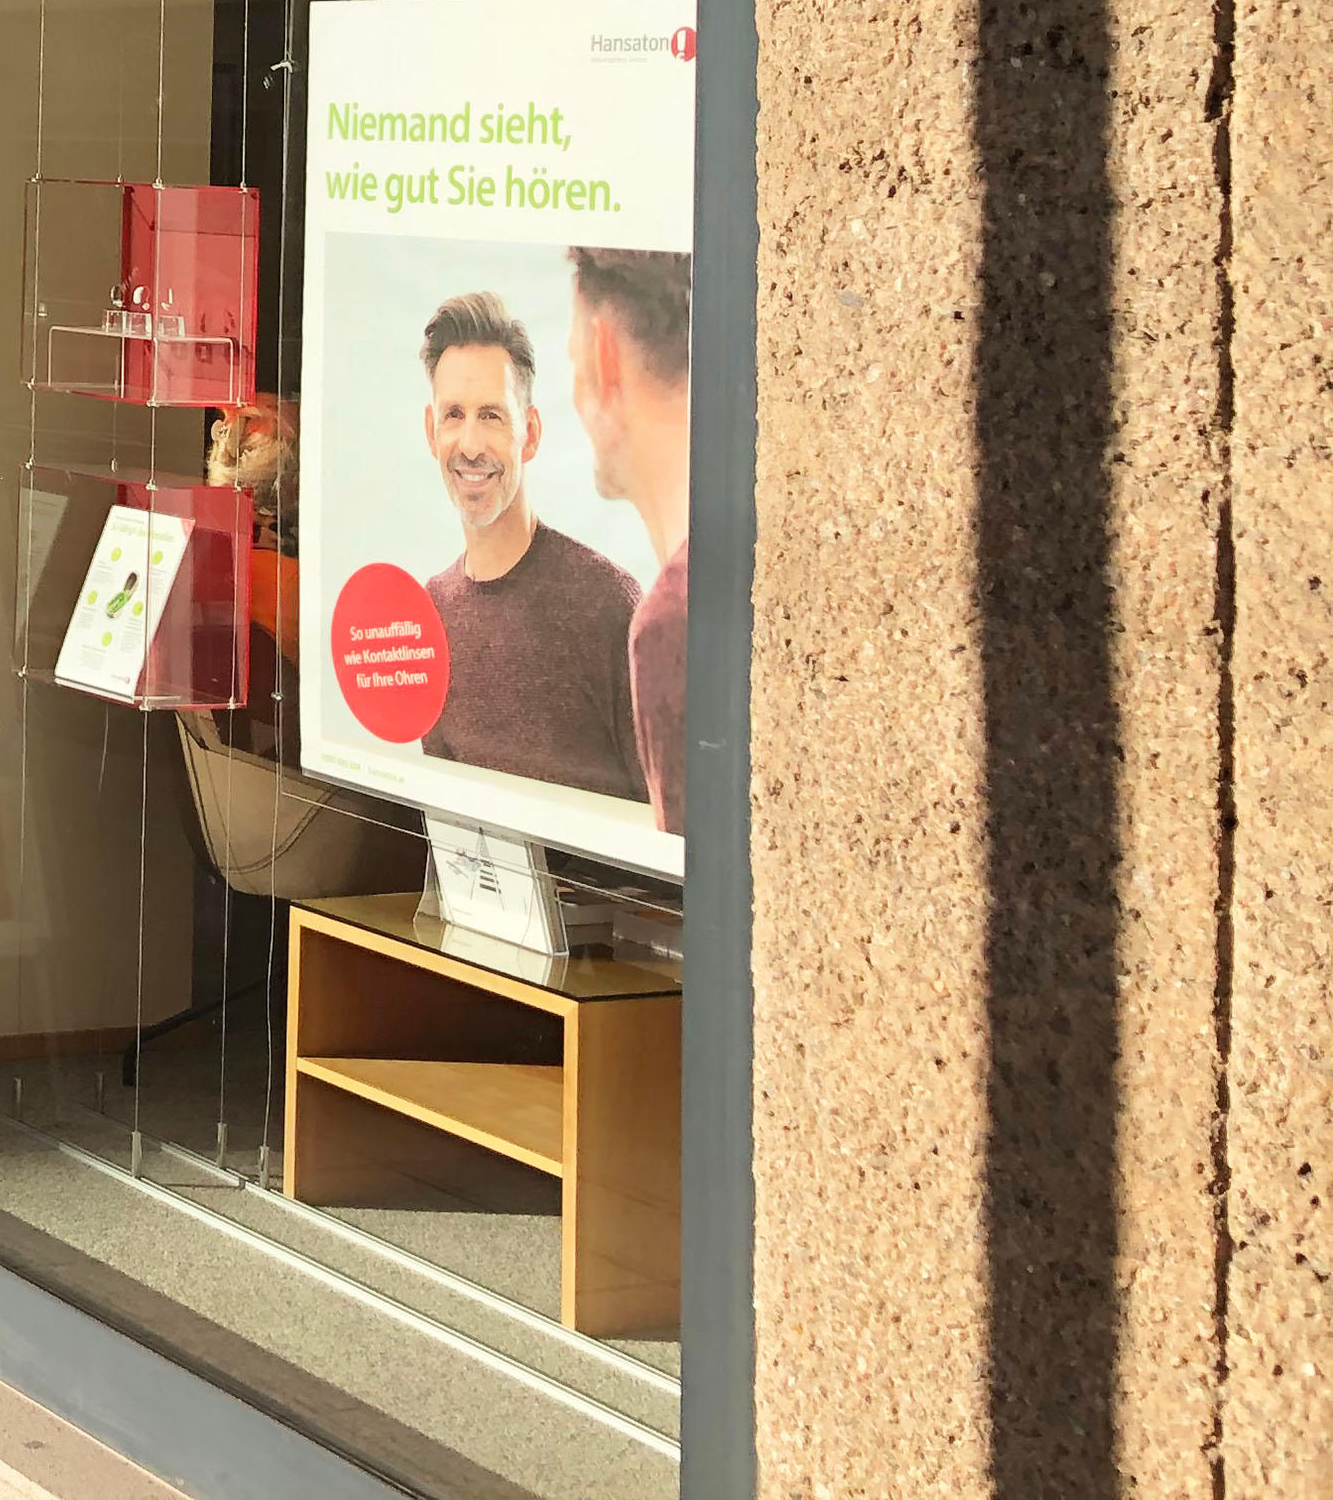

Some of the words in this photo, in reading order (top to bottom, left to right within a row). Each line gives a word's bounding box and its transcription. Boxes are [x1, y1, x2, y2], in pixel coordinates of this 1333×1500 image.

[590, 34, 669, 52] Hansaton
[327, 101, 471, 143] Niemand
[479, 101, 572, 151] sieht,
[326, 161, 378, 202] wie
[385, 167, 439, 214] gut
[447, 164, 496, 207] Sie
[505, 164, 621, 213] hören.
[349, 625, 363, 641] So
[365, 620, 422, 640] unauffällig
[343, 650, 362, 665] wie
[362, 645, 435, 664] Kontaktlinsen
[356, 673, 371, 688] für
[372, 671, 393, 687] Ihre
[395, 670, 428, 686] Ohren
